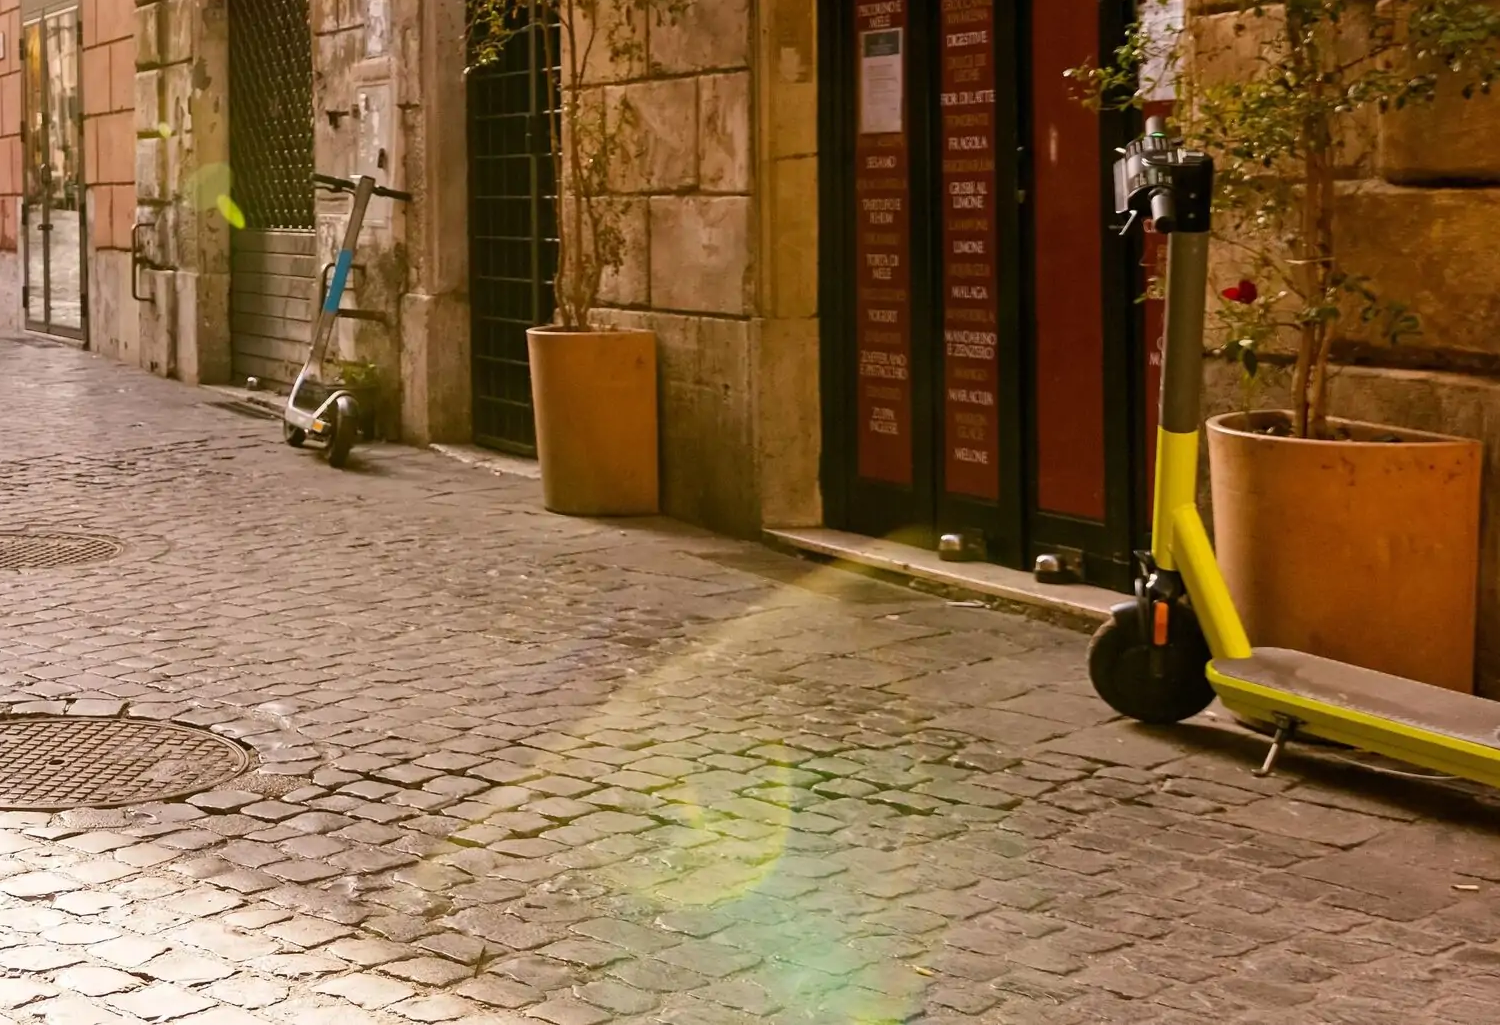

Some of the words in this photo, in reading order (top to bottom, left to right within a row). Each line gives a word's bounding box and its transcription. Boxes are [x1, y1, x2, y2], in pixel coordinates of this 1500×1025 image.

[947, 31, 987, 47] DIGESTIVE
[941, 93, 958, 106] FIOR
[969, 90, 994, 104] LATTE
[949, 136, 987, 149] FRAGOLA
[867, 156, 896, 168] SESAMO
[954, 196, 983, 208] LIMONE
[954, 241, 983, 253] LIMONE
[952, 287, 987, 299] MALAGA
[868, 310, 897, 322] YOGURT
[944, 330, 997, 346] MANDARINO
[870, 419, 898, 435] INGLESE
[955, 448, 987, 464] MELONE
